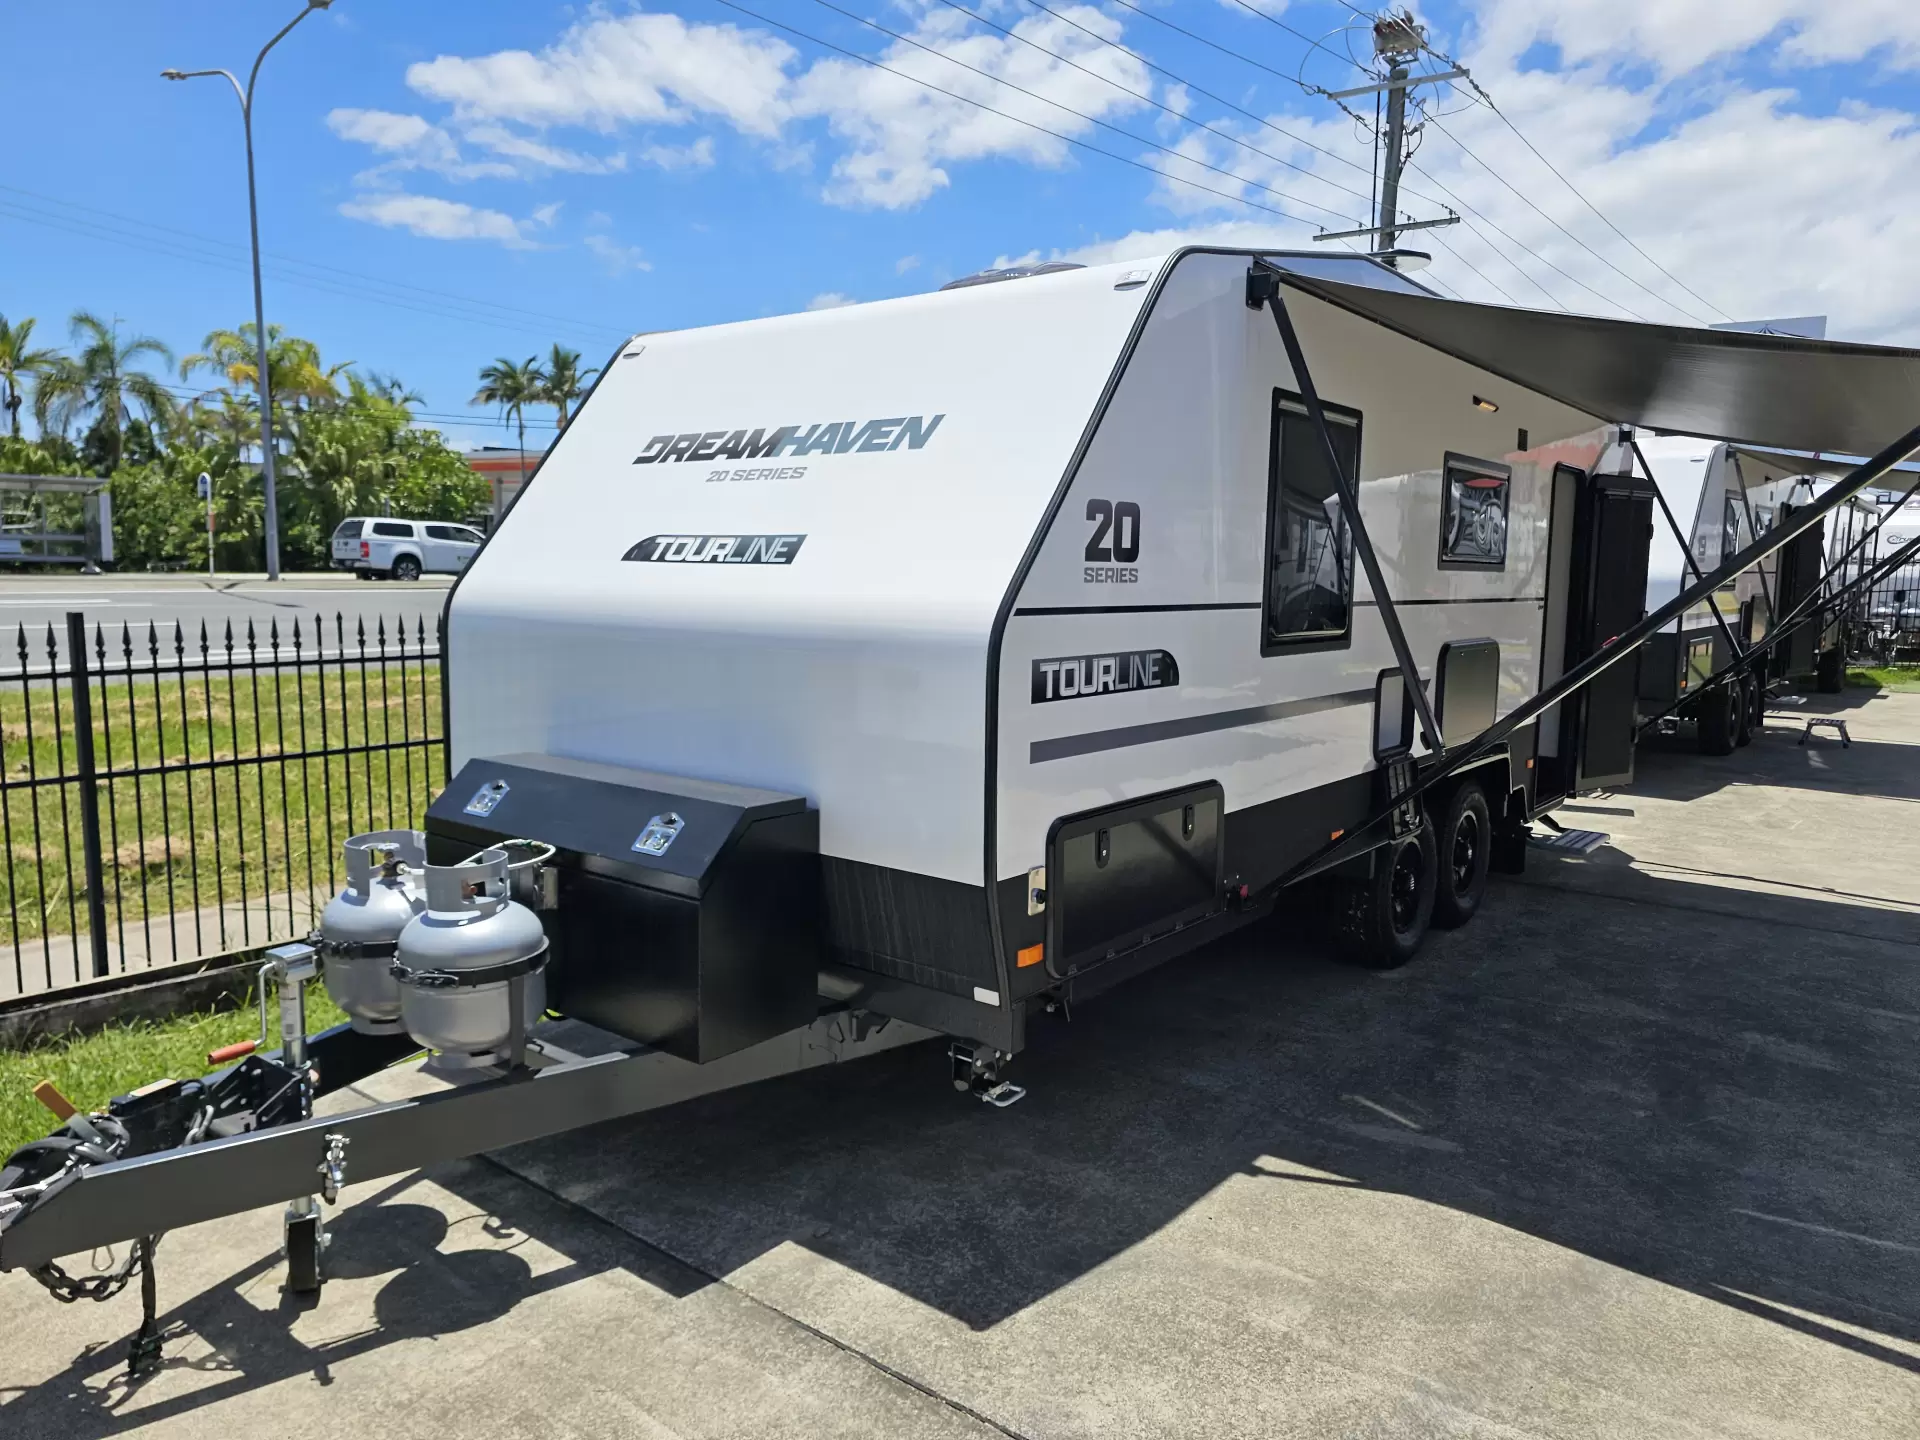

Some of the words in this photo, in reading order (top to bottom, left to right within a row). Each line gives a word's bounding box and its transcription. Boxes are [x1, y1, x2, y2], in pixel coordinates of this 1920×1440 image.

[706, 470, 729, 482] 20
[730, 466, 807, 481] SERIES
[1085, 498, 1141, 563] 20
[650, 536, 799, 563] TOURLINE
[1084, 567, 1138, 583] SERIES
[1040, 653, 1163, 698] TOURLINE
